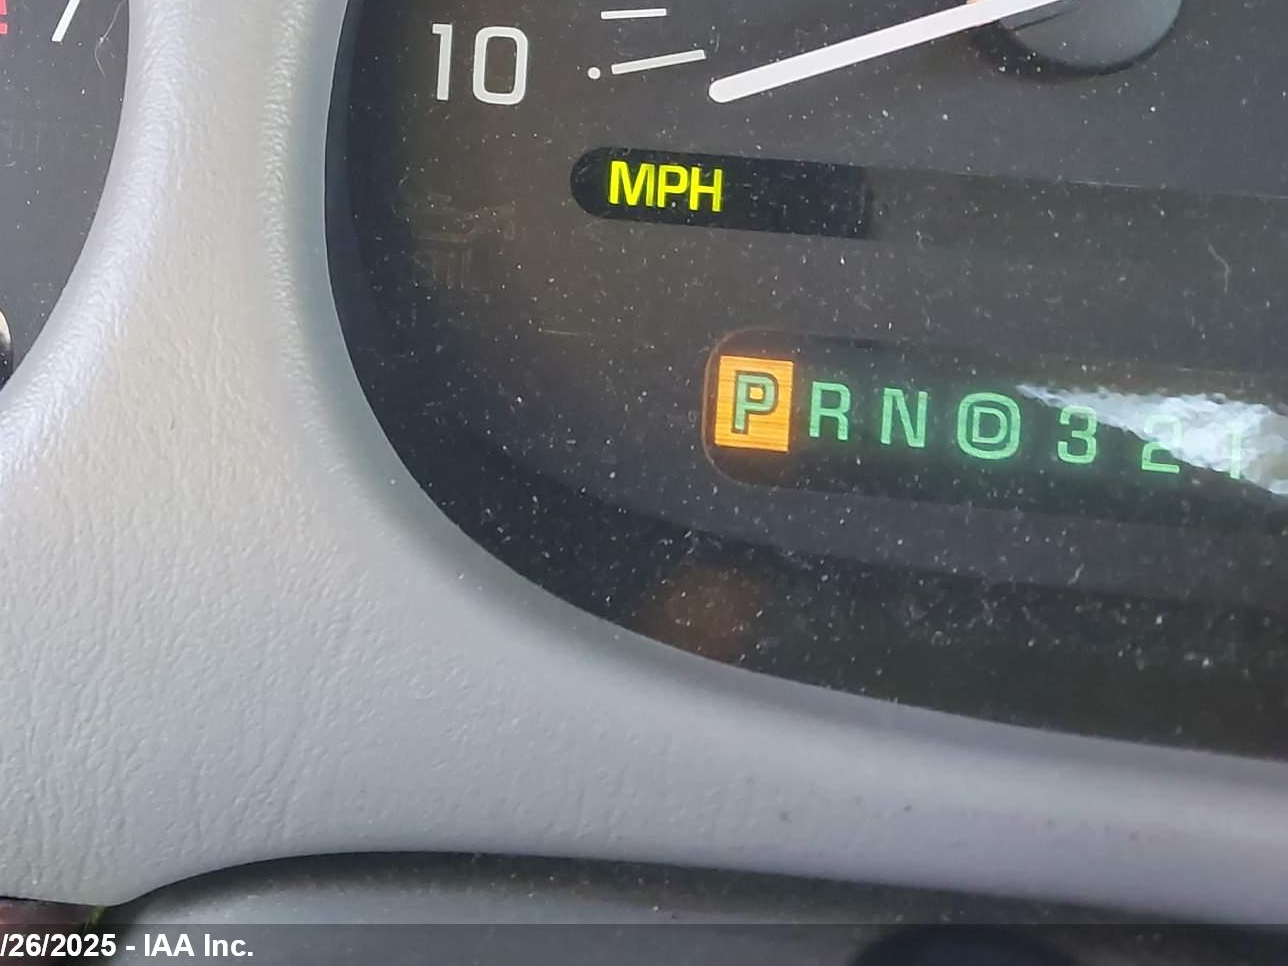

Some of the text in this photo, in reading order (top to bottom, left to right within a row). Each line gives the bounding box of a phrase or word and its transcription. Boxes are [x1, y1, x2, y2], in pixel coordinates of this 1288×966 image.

[432, 23, 529, 105] 10
[609, 160, 723, 212] MPH
[733, 372, 778, 435] P
[808, 381, 852, 442] R
[879, 387, 929, 449] N
[1056, 404, 1099, 465] 3
[1141, 413, 1183, 475] 2
